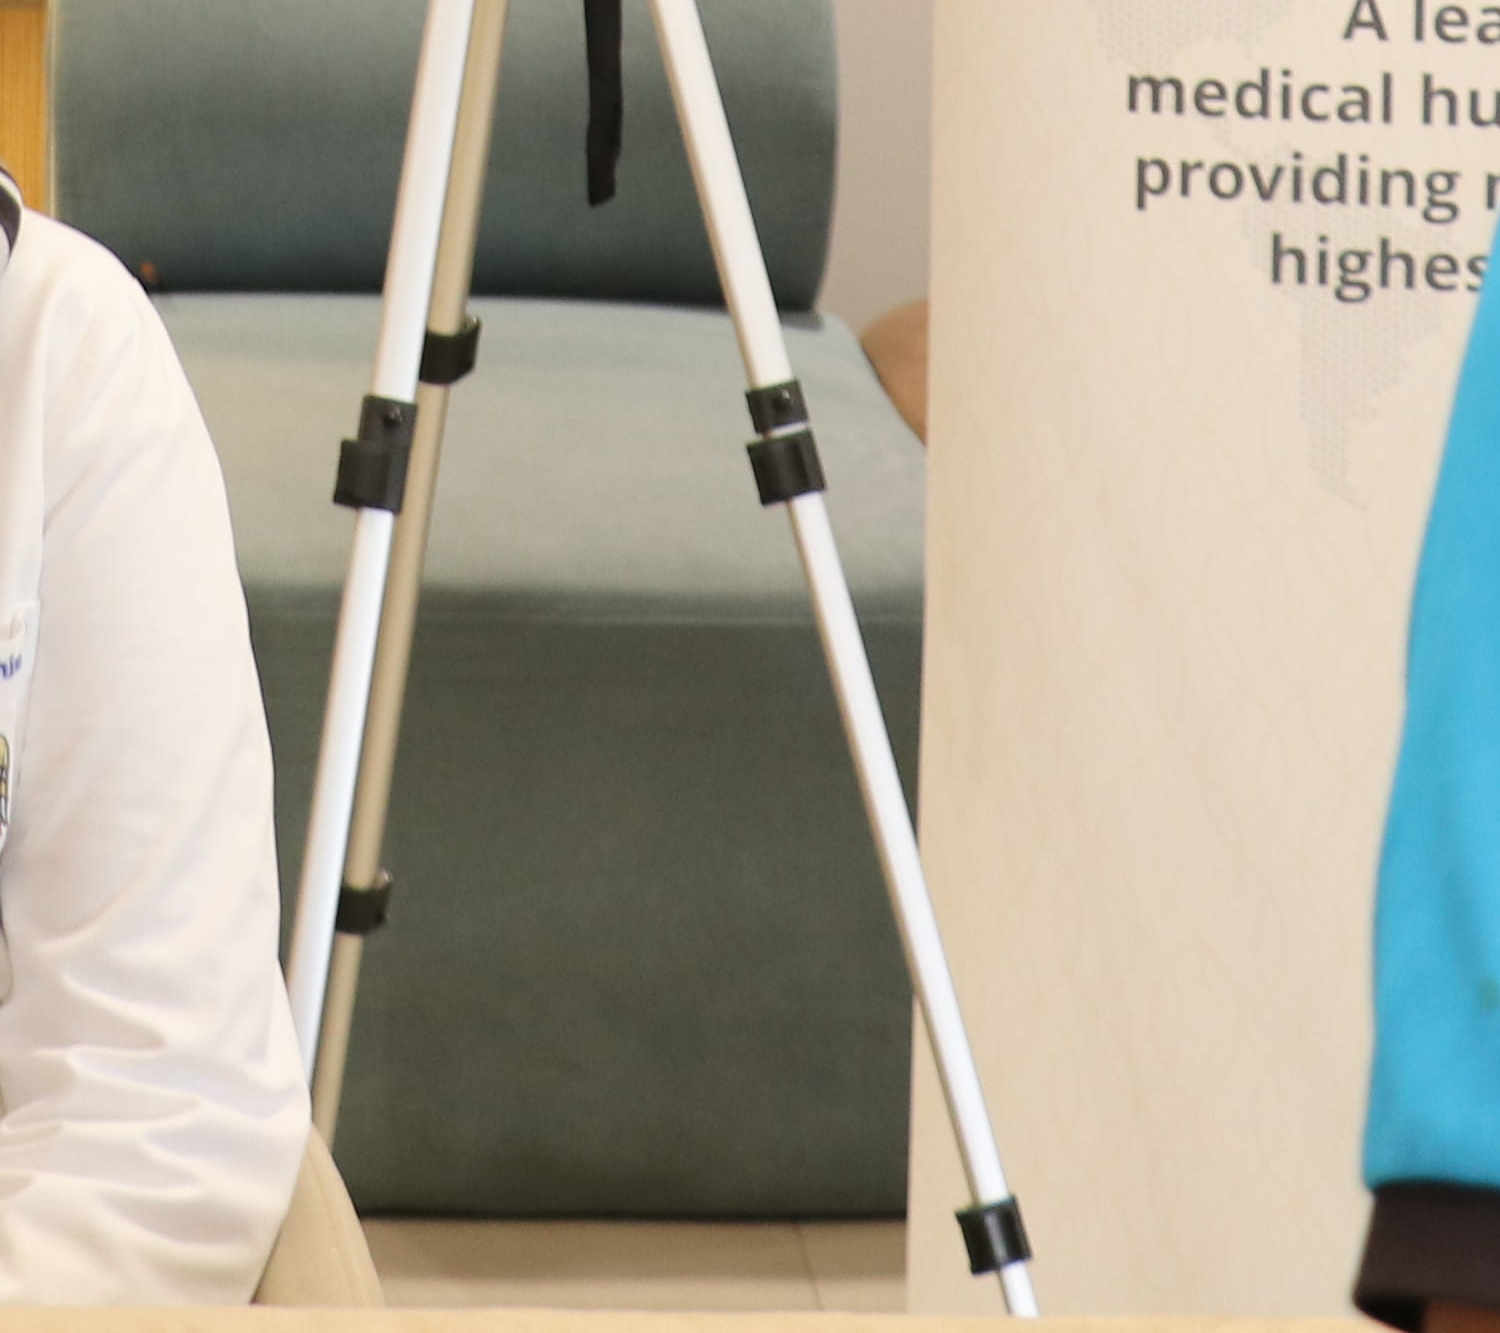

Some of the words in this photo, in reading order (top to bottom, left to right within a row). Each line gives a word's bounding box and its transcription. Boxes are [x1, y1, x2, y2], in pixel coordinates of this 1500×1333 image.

[1127, 67, 1393, 125] medical
[1135, 153, 1461, 225] providing
[1270, 233, 1488, 304] highes
